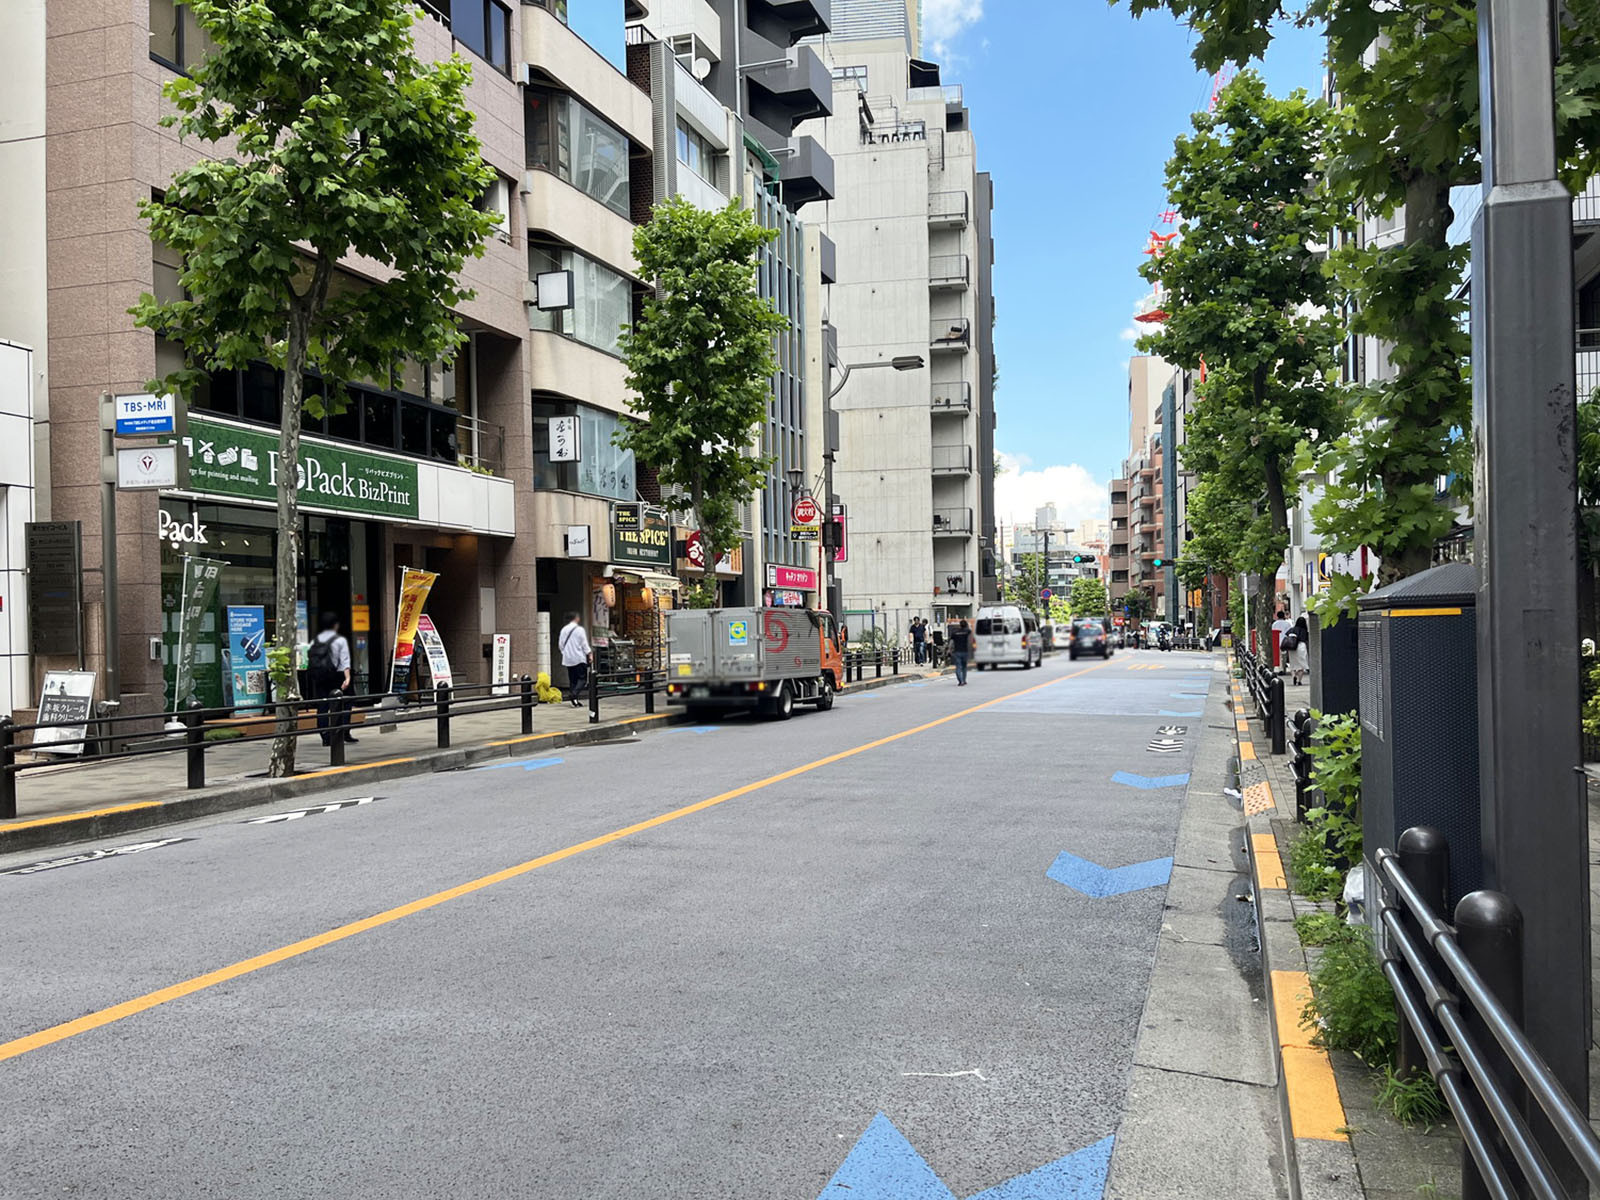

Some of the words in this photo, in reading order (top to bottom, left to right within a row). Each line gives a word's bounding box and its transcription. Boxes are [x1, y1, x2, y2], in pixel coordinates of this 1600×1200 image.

[124, 401, 166, 412] TBS-MRI
[358, 478, 411, 506] BizPrint
[44, 703, 87, 713] 赤坂クレール
[42, 713, 86, 722] 歯科クリニック
